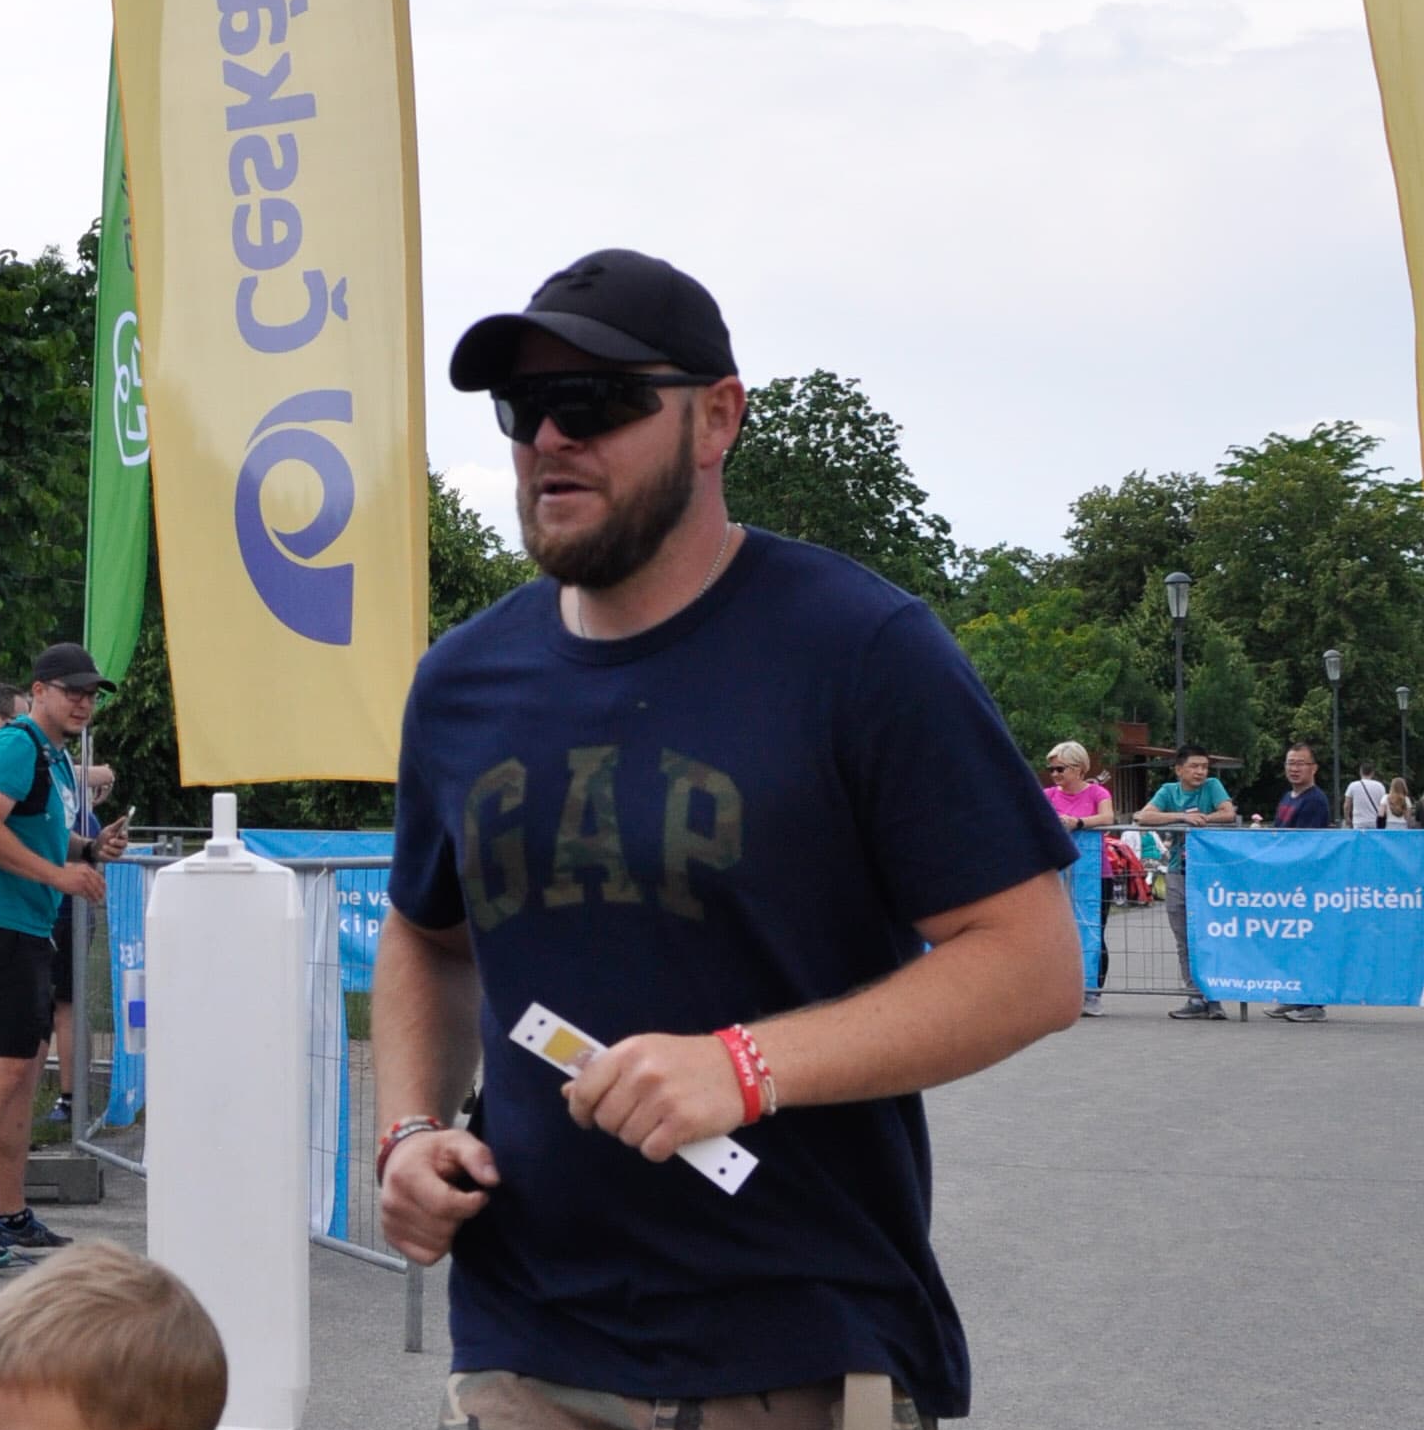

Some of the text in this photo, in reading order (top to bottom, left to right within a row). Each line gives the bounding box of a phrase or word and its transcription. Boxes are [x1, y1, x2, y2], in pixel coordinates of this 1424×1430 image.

[463, 744, 746, 933] GAP
[1206, 881, 1423, 914] Úrazové pojištění
[1206, 916, 1314, 940] od PVZP
[1206, 975, 1303, 993] www.pvzp.cz
